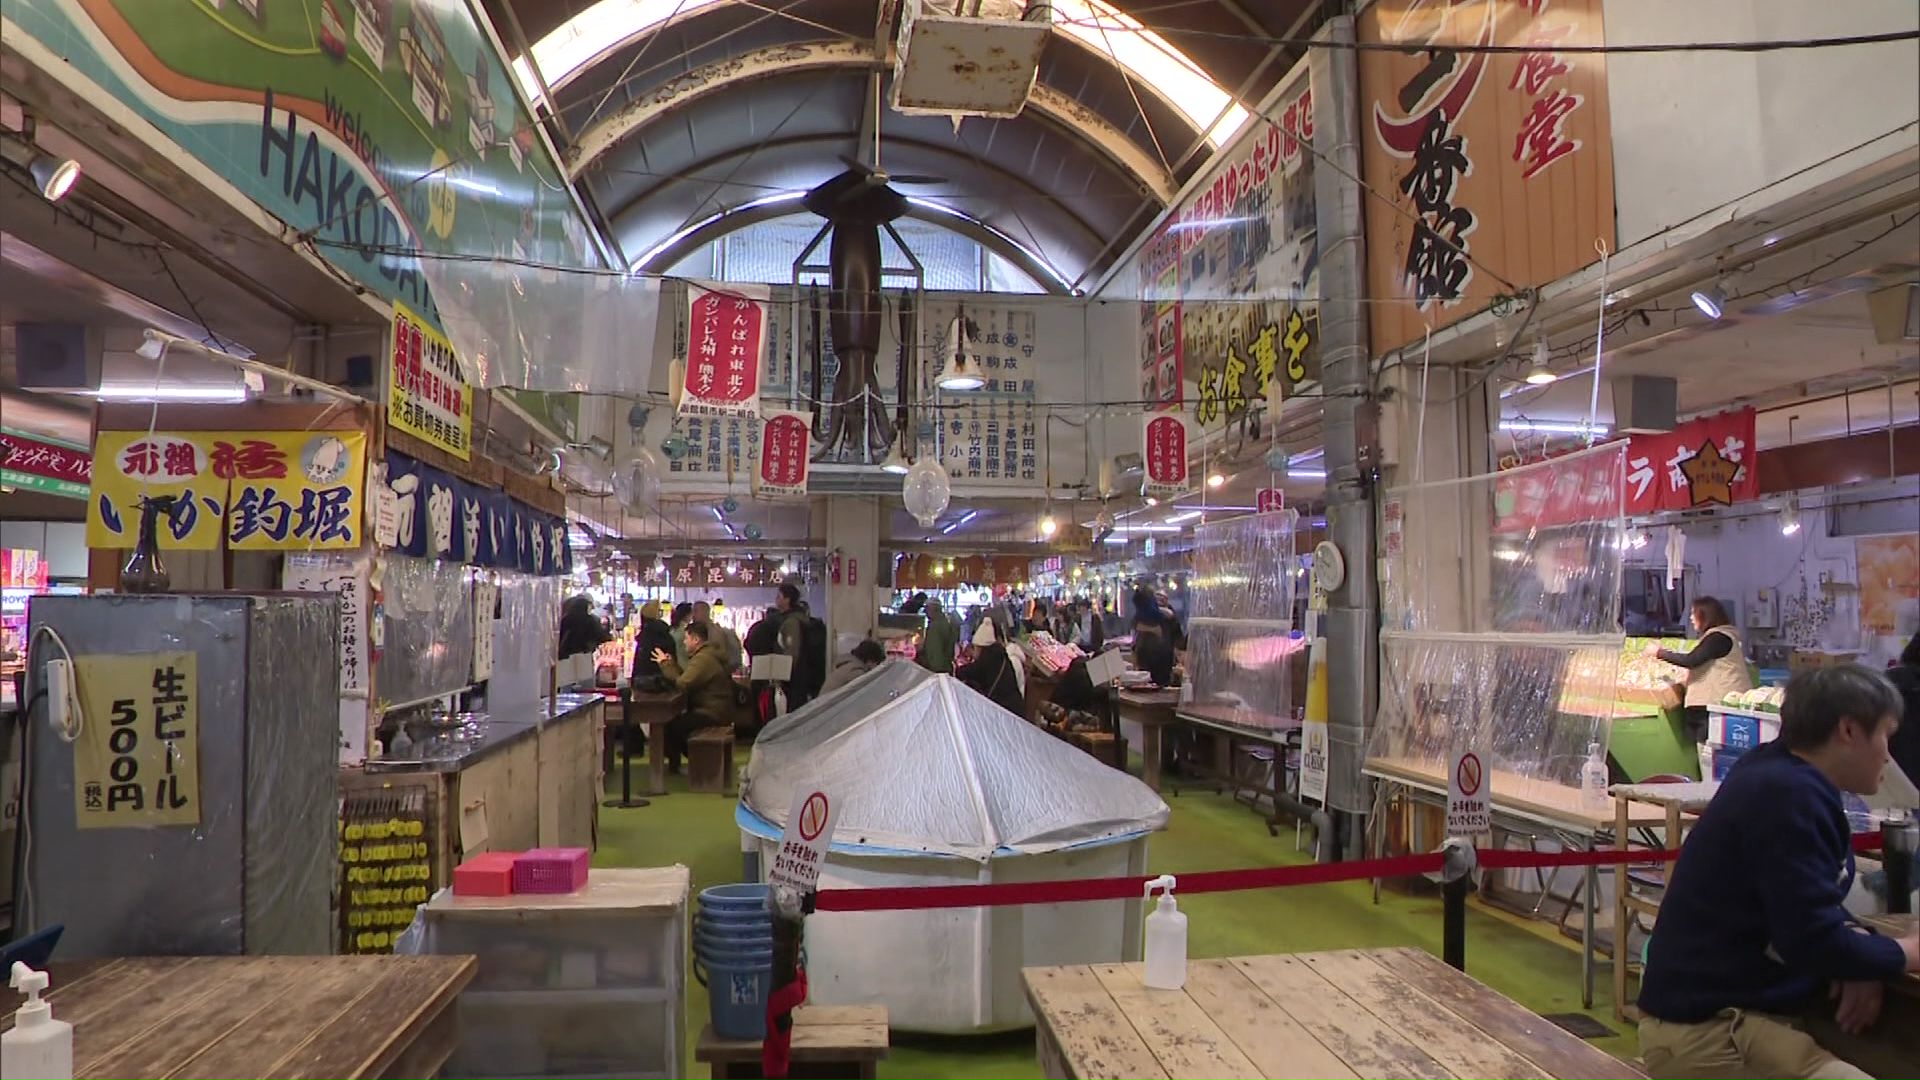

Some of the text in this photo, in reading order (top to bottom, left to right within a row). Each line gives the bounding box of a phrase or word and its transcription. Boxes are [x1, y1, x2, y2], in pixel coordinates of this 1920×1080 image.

[1508, 0, 1578, 180] 食堂
[1198, 310, 1309, 423] お食事を
[123, 440, 289, 480] 元祖 活
[107, 699, 145, 813] 500円
[152, 666, 189, 810] 生ビール
